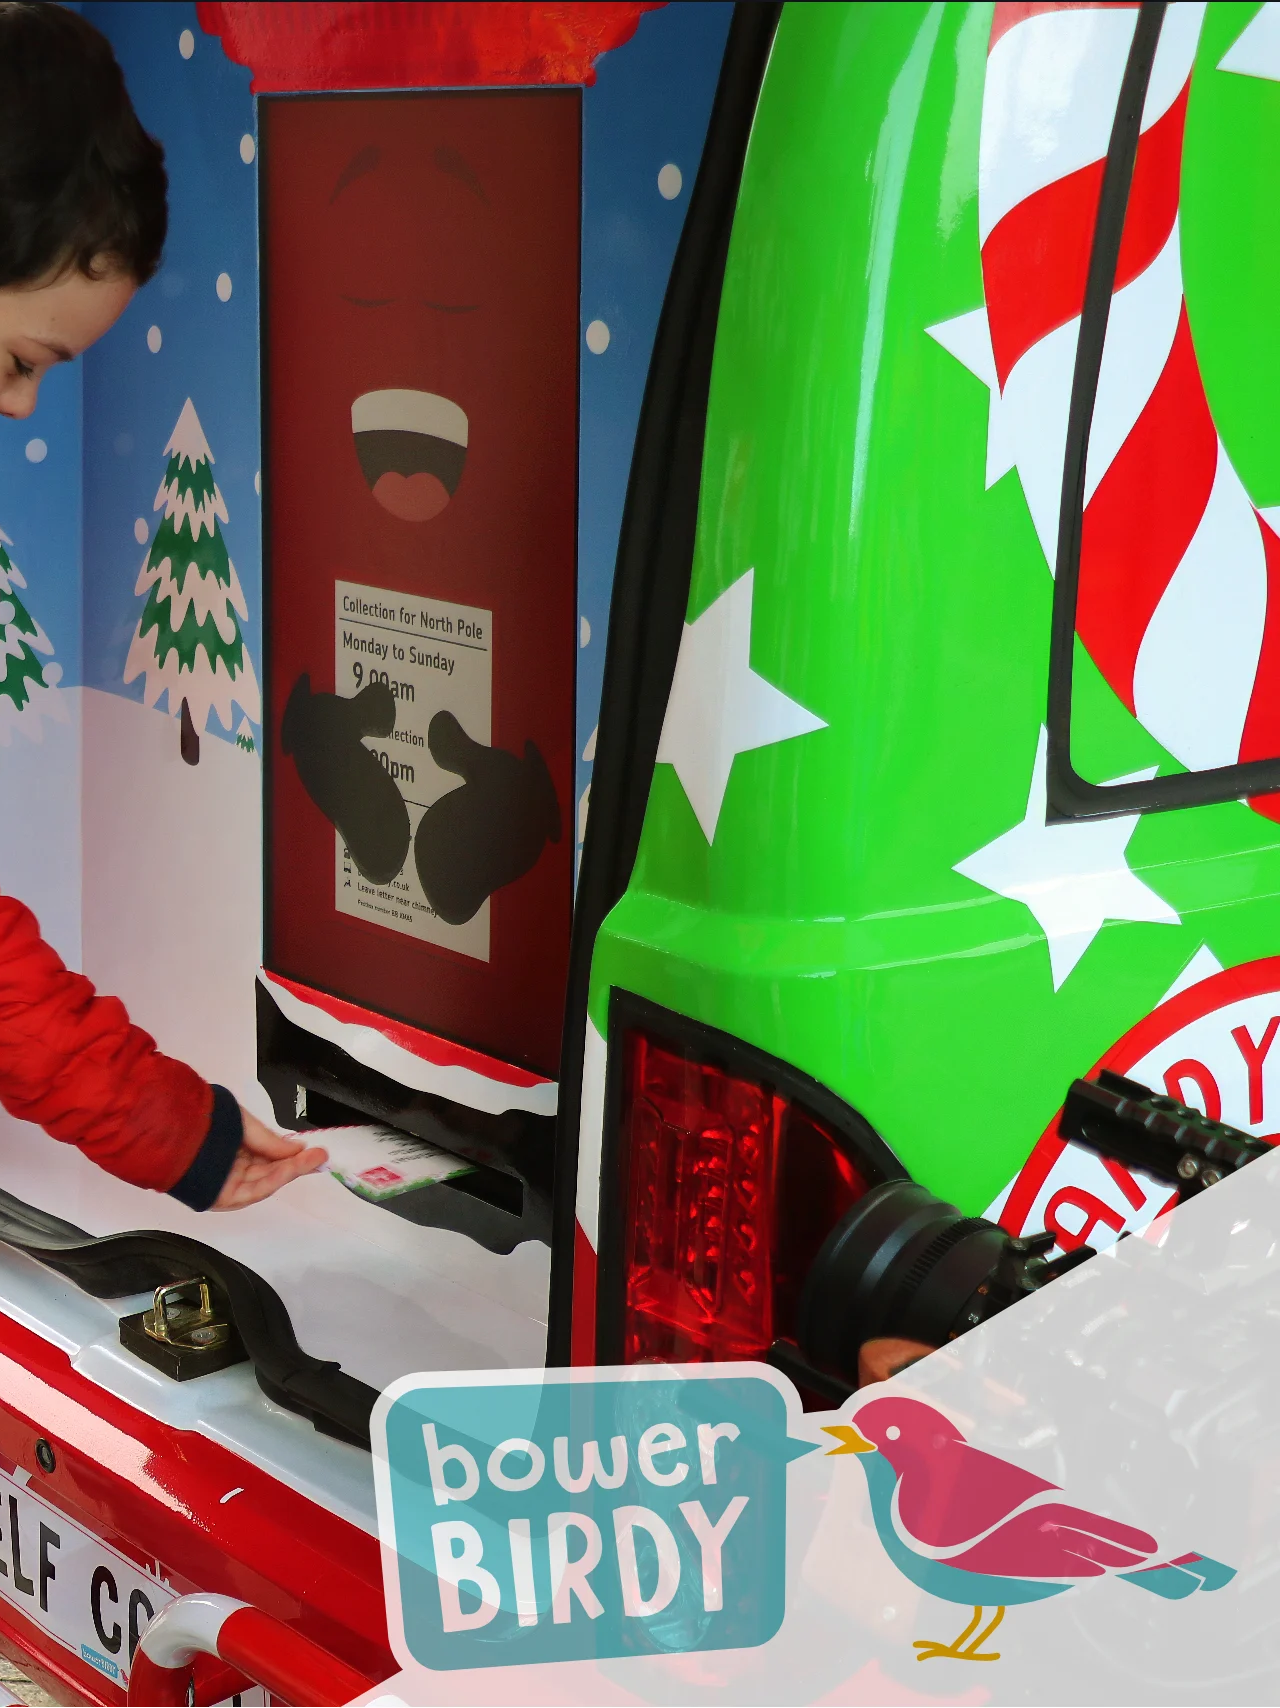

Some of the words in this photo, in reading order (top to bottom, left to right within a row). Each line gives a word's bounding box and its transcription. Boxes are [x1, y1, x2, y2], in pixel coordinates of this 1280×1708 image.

[343, 595, 395, 621] Collection
[400, 607, 416, 625] for
[420, 611, 453, 633] North
[458, 619, 483, 640] Pole
[343, 631, 389, 661] Monday
[393, 644, 405, 661] to
[409, 646, 455, 676] Sunday
[358, 882, 375, 895] Leave
[377, 888, 394, 901] letter
[396, 896, 410, 908] near
